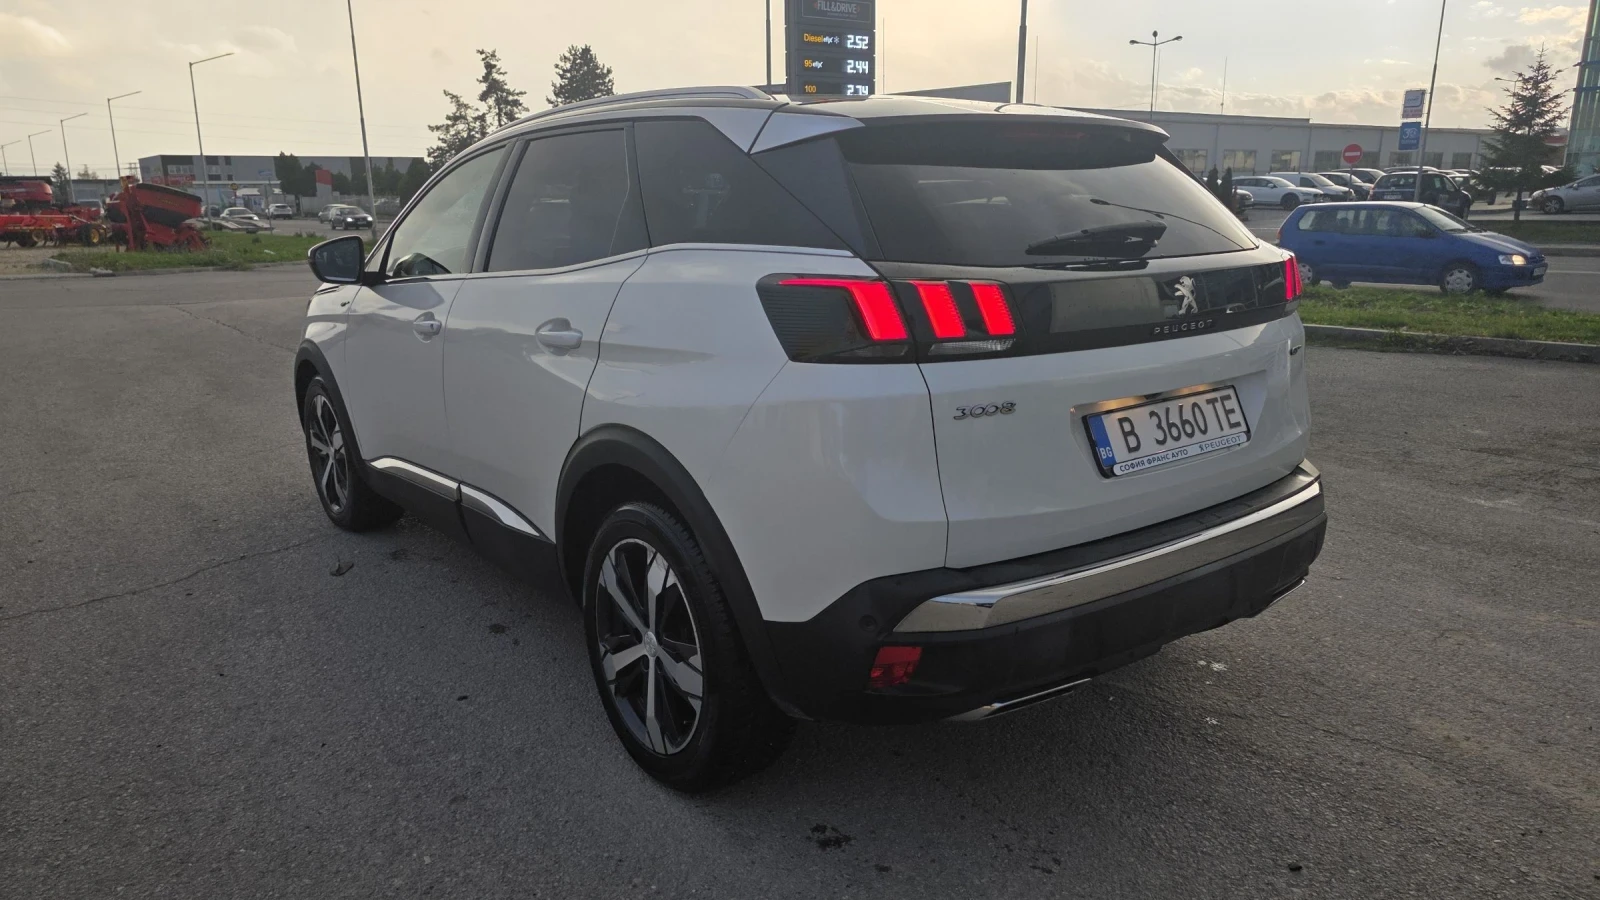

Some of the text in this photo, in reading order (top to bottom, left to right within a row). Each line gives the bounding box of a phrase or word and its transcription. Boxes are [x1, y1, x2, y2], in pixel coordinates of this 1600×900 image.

[818, 1, 857, 13] FILL&DRIVE
[847, 35, 868, 49] 2.52
[847, 60, 868, 74] 2.44
[804, 85, 868, 95] 100 274
[1154, 319, 1213, 335] PEUGEOT
[953, 401, 1017, 421] 3008
[1118, 394, 1241, 453] B 3660 TE
[1099, 446, 1114, 460] BG
[1119, 436, 1241, 473] СОФИЯ ФРАНС АУТО PEUGEOT
